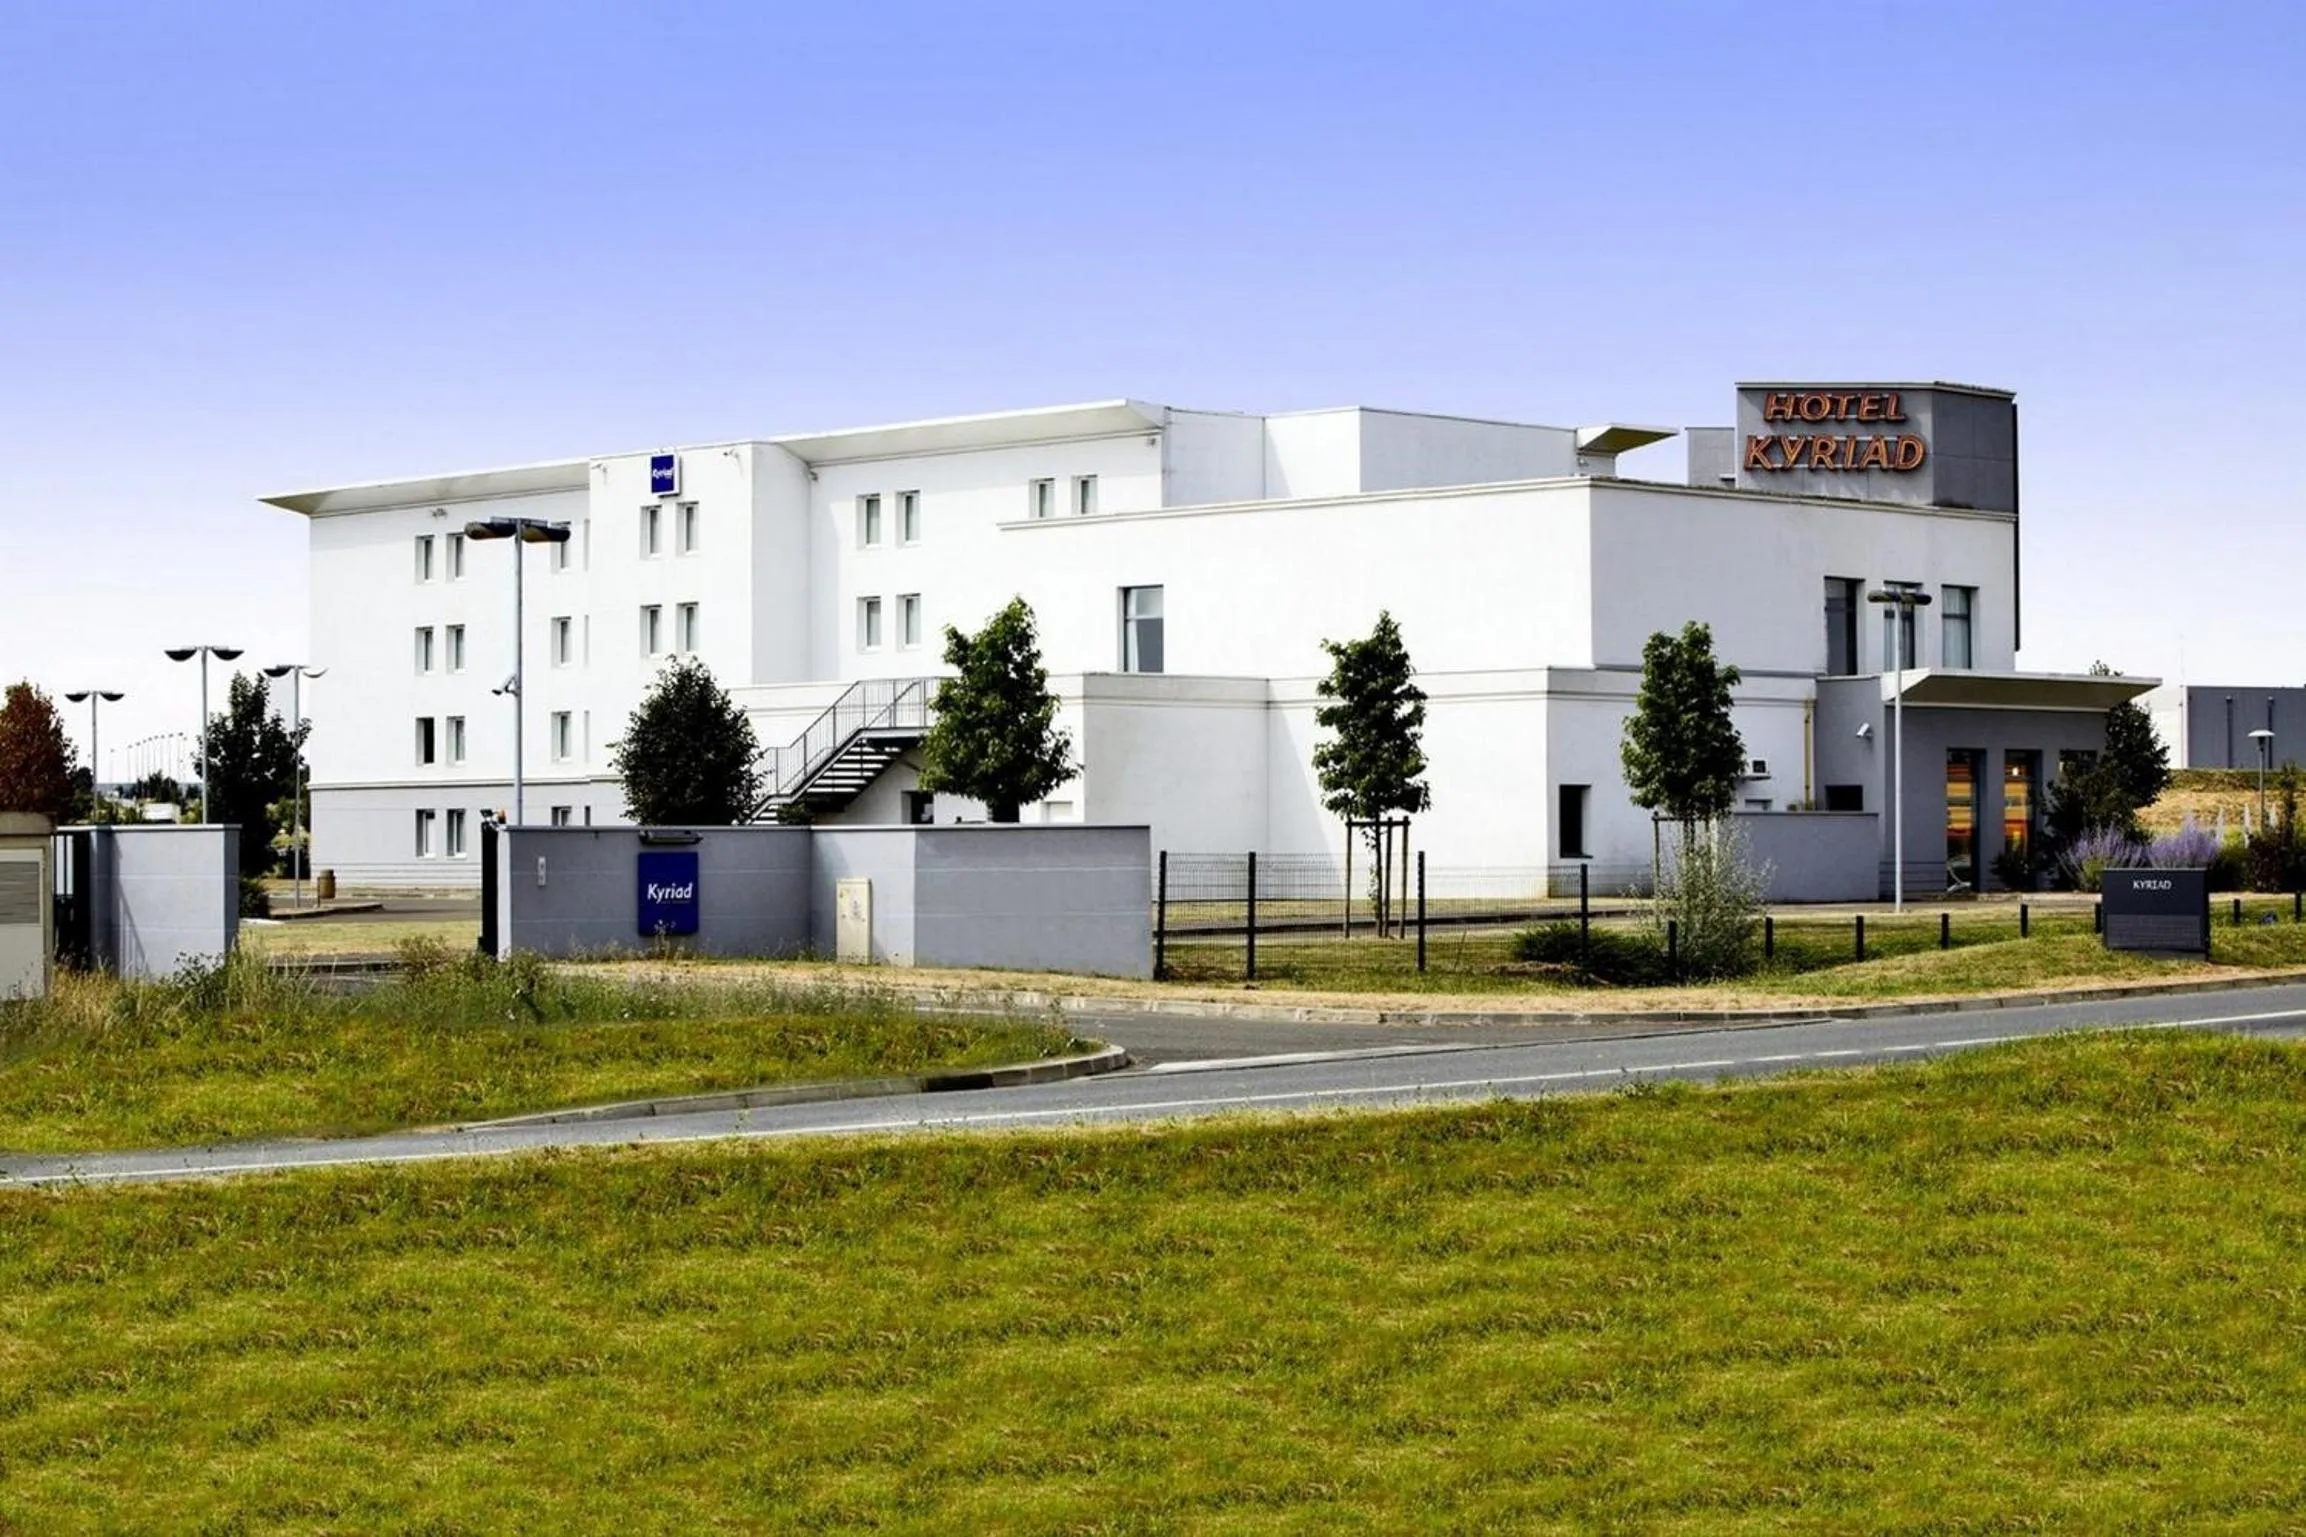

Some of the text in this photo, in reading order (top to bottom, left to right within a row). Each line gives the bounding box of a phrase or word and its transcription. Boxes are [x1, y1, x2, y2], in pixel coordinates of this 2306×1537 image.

[1764, 392, 1907, 422] HOTEL
[1744, 434, 1927, 472] KYRIAD
[647, 882, 693, 904] Kyriad
[2132, 880, 2172, 890] KYRIAD
